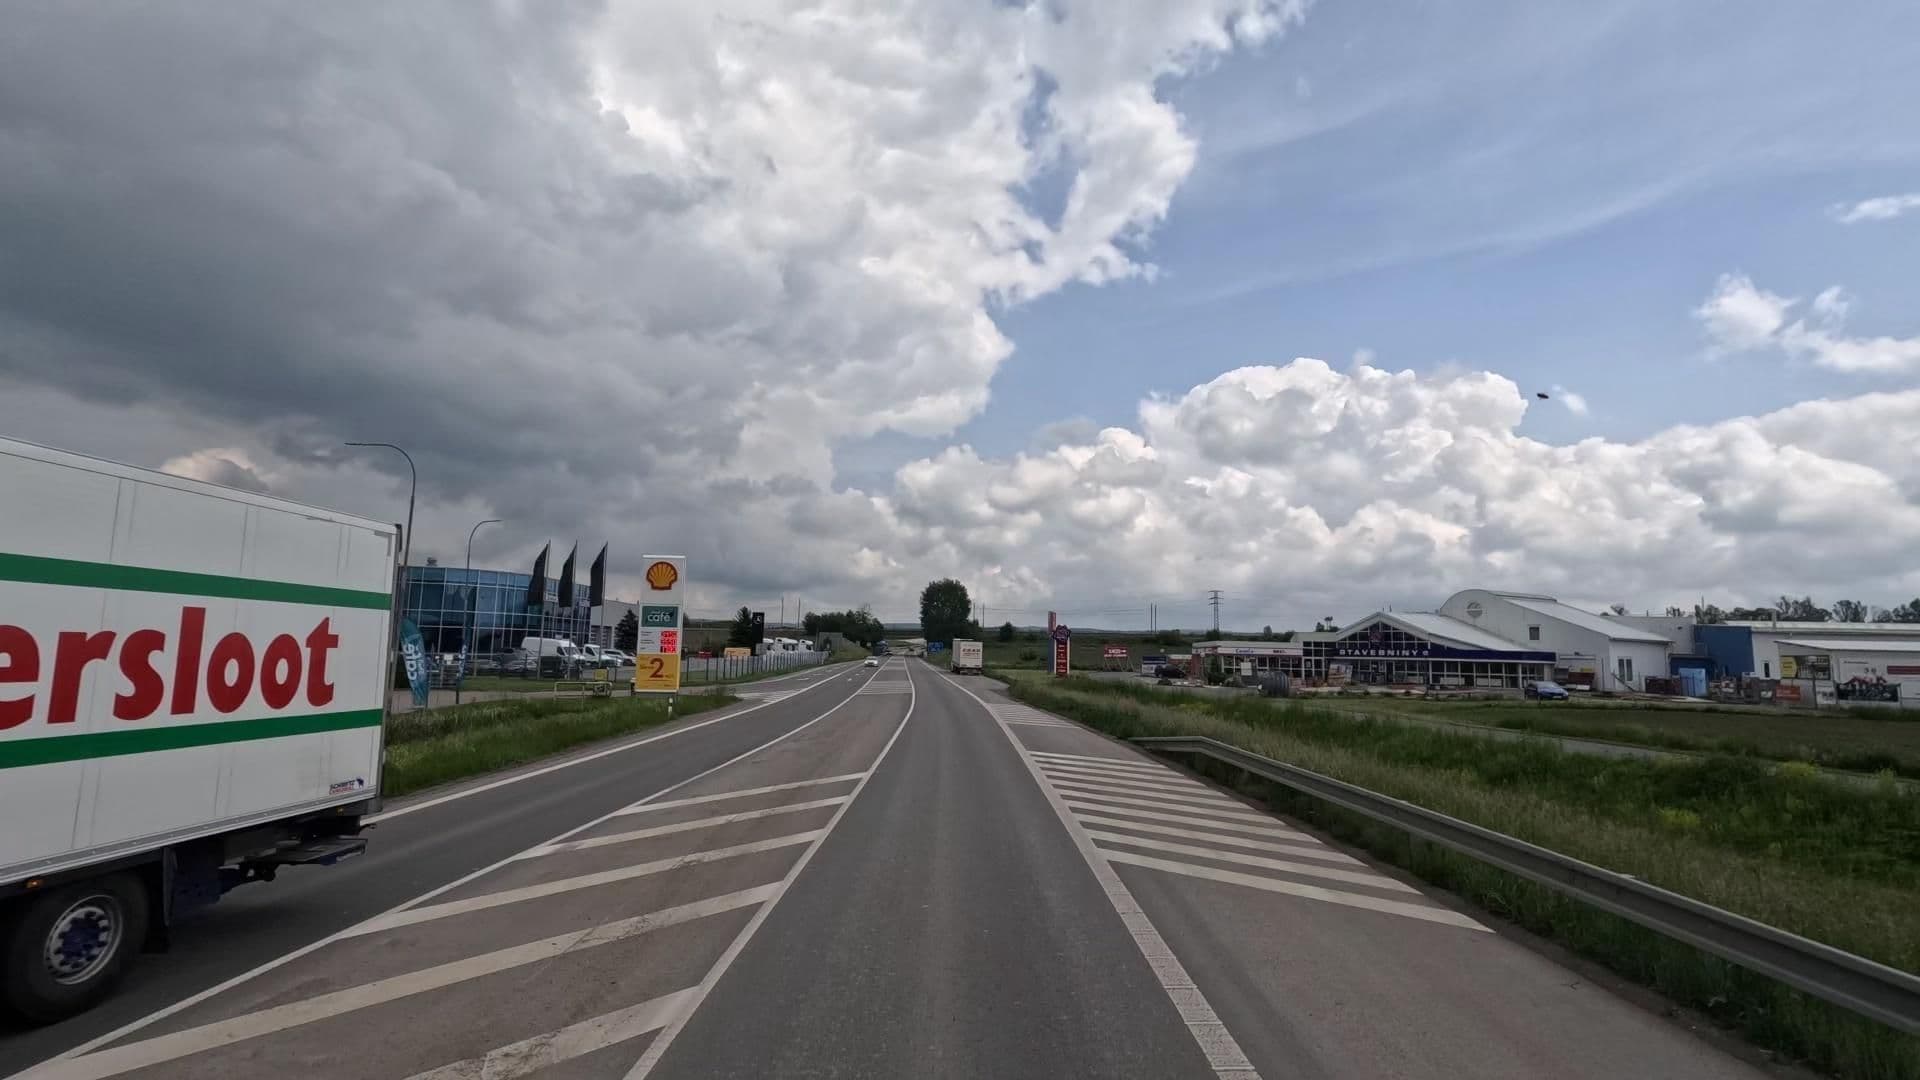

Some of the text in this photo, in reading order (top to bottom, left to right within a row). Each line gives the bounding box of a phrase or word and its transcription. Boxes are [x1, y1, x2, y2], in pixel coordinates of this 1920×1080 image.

[647, 611, 671, 622] café
[0, 606, 339, 730] ersloot
[650, 657, 664, 678] 2
